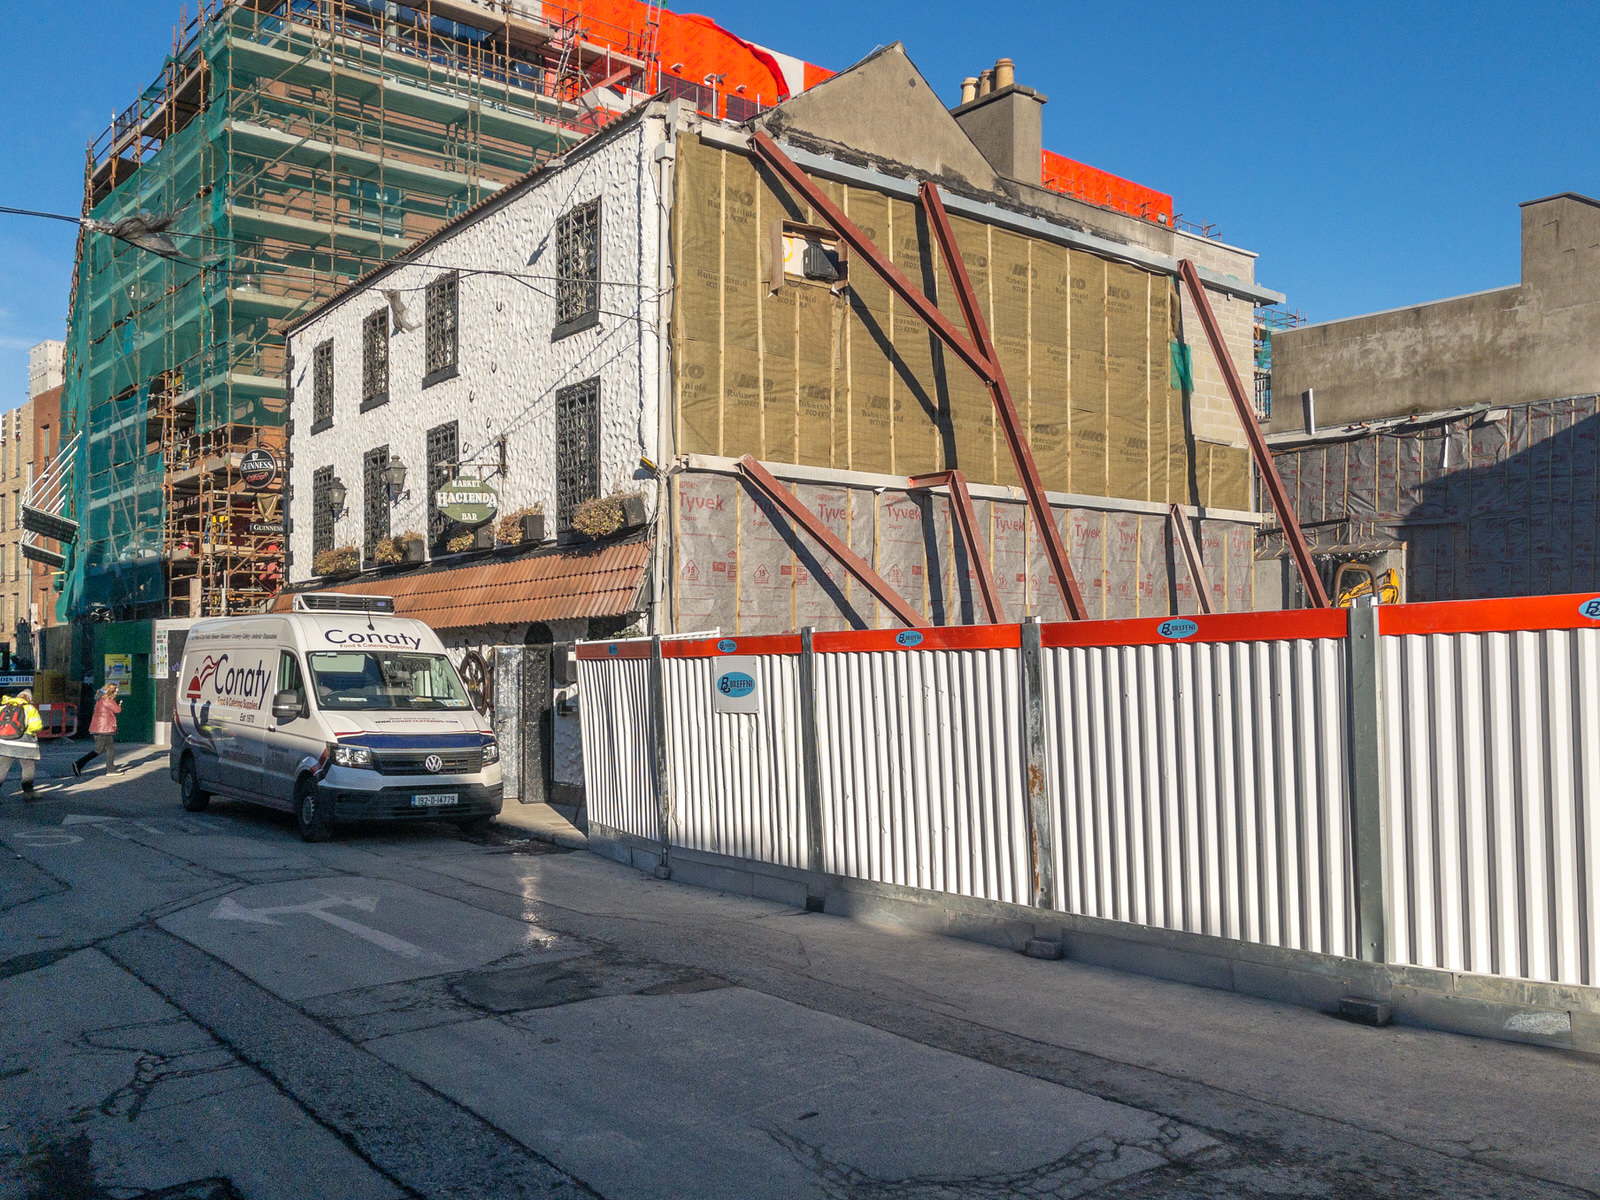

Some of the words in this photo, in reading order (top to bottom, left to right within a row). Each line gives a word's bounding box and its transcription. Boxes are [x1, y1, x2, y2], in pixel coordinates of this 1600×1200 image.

[241, 460, 274, 472] GUINNESS
[451, 480, 481, 488] MARKET
[437, 492, 498, 508] HACIENDA
[679, 491, 724, 513] Tyvek
[461, 512, 478, 521] BAR
[253, 524, 284, 532] GUINNESS
[324, 629, 421, 650] Conaty
[214, 653, 272, 710] Conaty
[729, 679, 753, 689] BREFFNI
[217, 696, 226, 706] Food
[228, 697, 243, 709] Catering
[243, 698, 258, 711] Supplies
